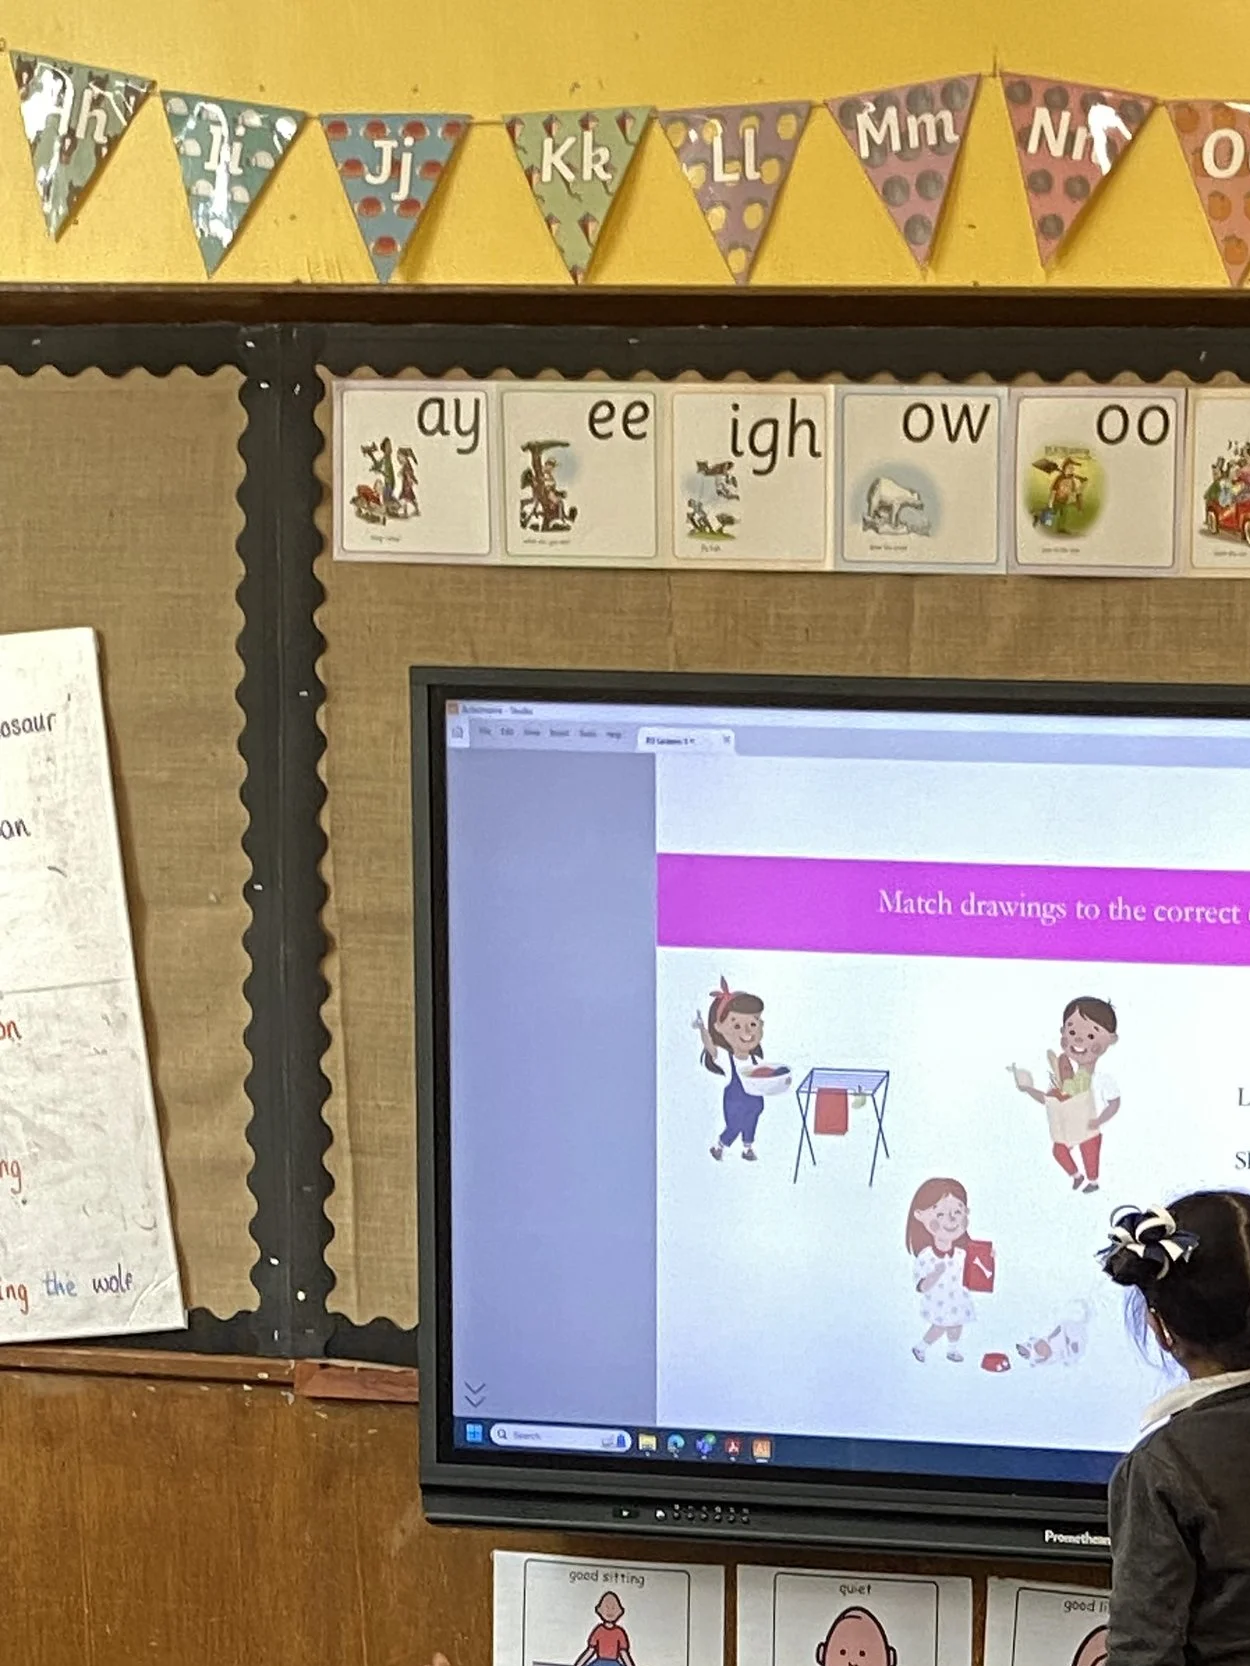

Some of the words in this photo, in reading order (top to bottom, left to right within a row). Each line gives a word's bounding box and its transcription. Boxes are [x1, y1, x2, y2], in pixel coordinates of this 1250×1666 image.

[856, 105, 960, 159] Mm
[364, 138, 413, 203] Jj
[541, 135, 613, 185] Kk
[712, 127, 760, 183] Ll
[417, 396, 482, 454] ay
[587, 398, 651, 441] ee
[729, 398, 822, 476] igh
[902, 402, 991, 444] ow
[1096, 403, 1170, 446] oo
[877, 888, 953, 916] Match
[960, 891, 1067, 926] drawings
[1076, 899, 1100, 920] to
[1108, 896, 1146, 922] the
[1153, 900, 1241, 925] correct
[42, 1270, 77, 1297] the
[92, 1262, 132, 1294] wolf
[569, 1569, 599, 1583] good
[602, 1570, 645, 1588] sitting
[839, 1583, 872, 1598] quiet
[1064, 1600, 1095, 1613] good
